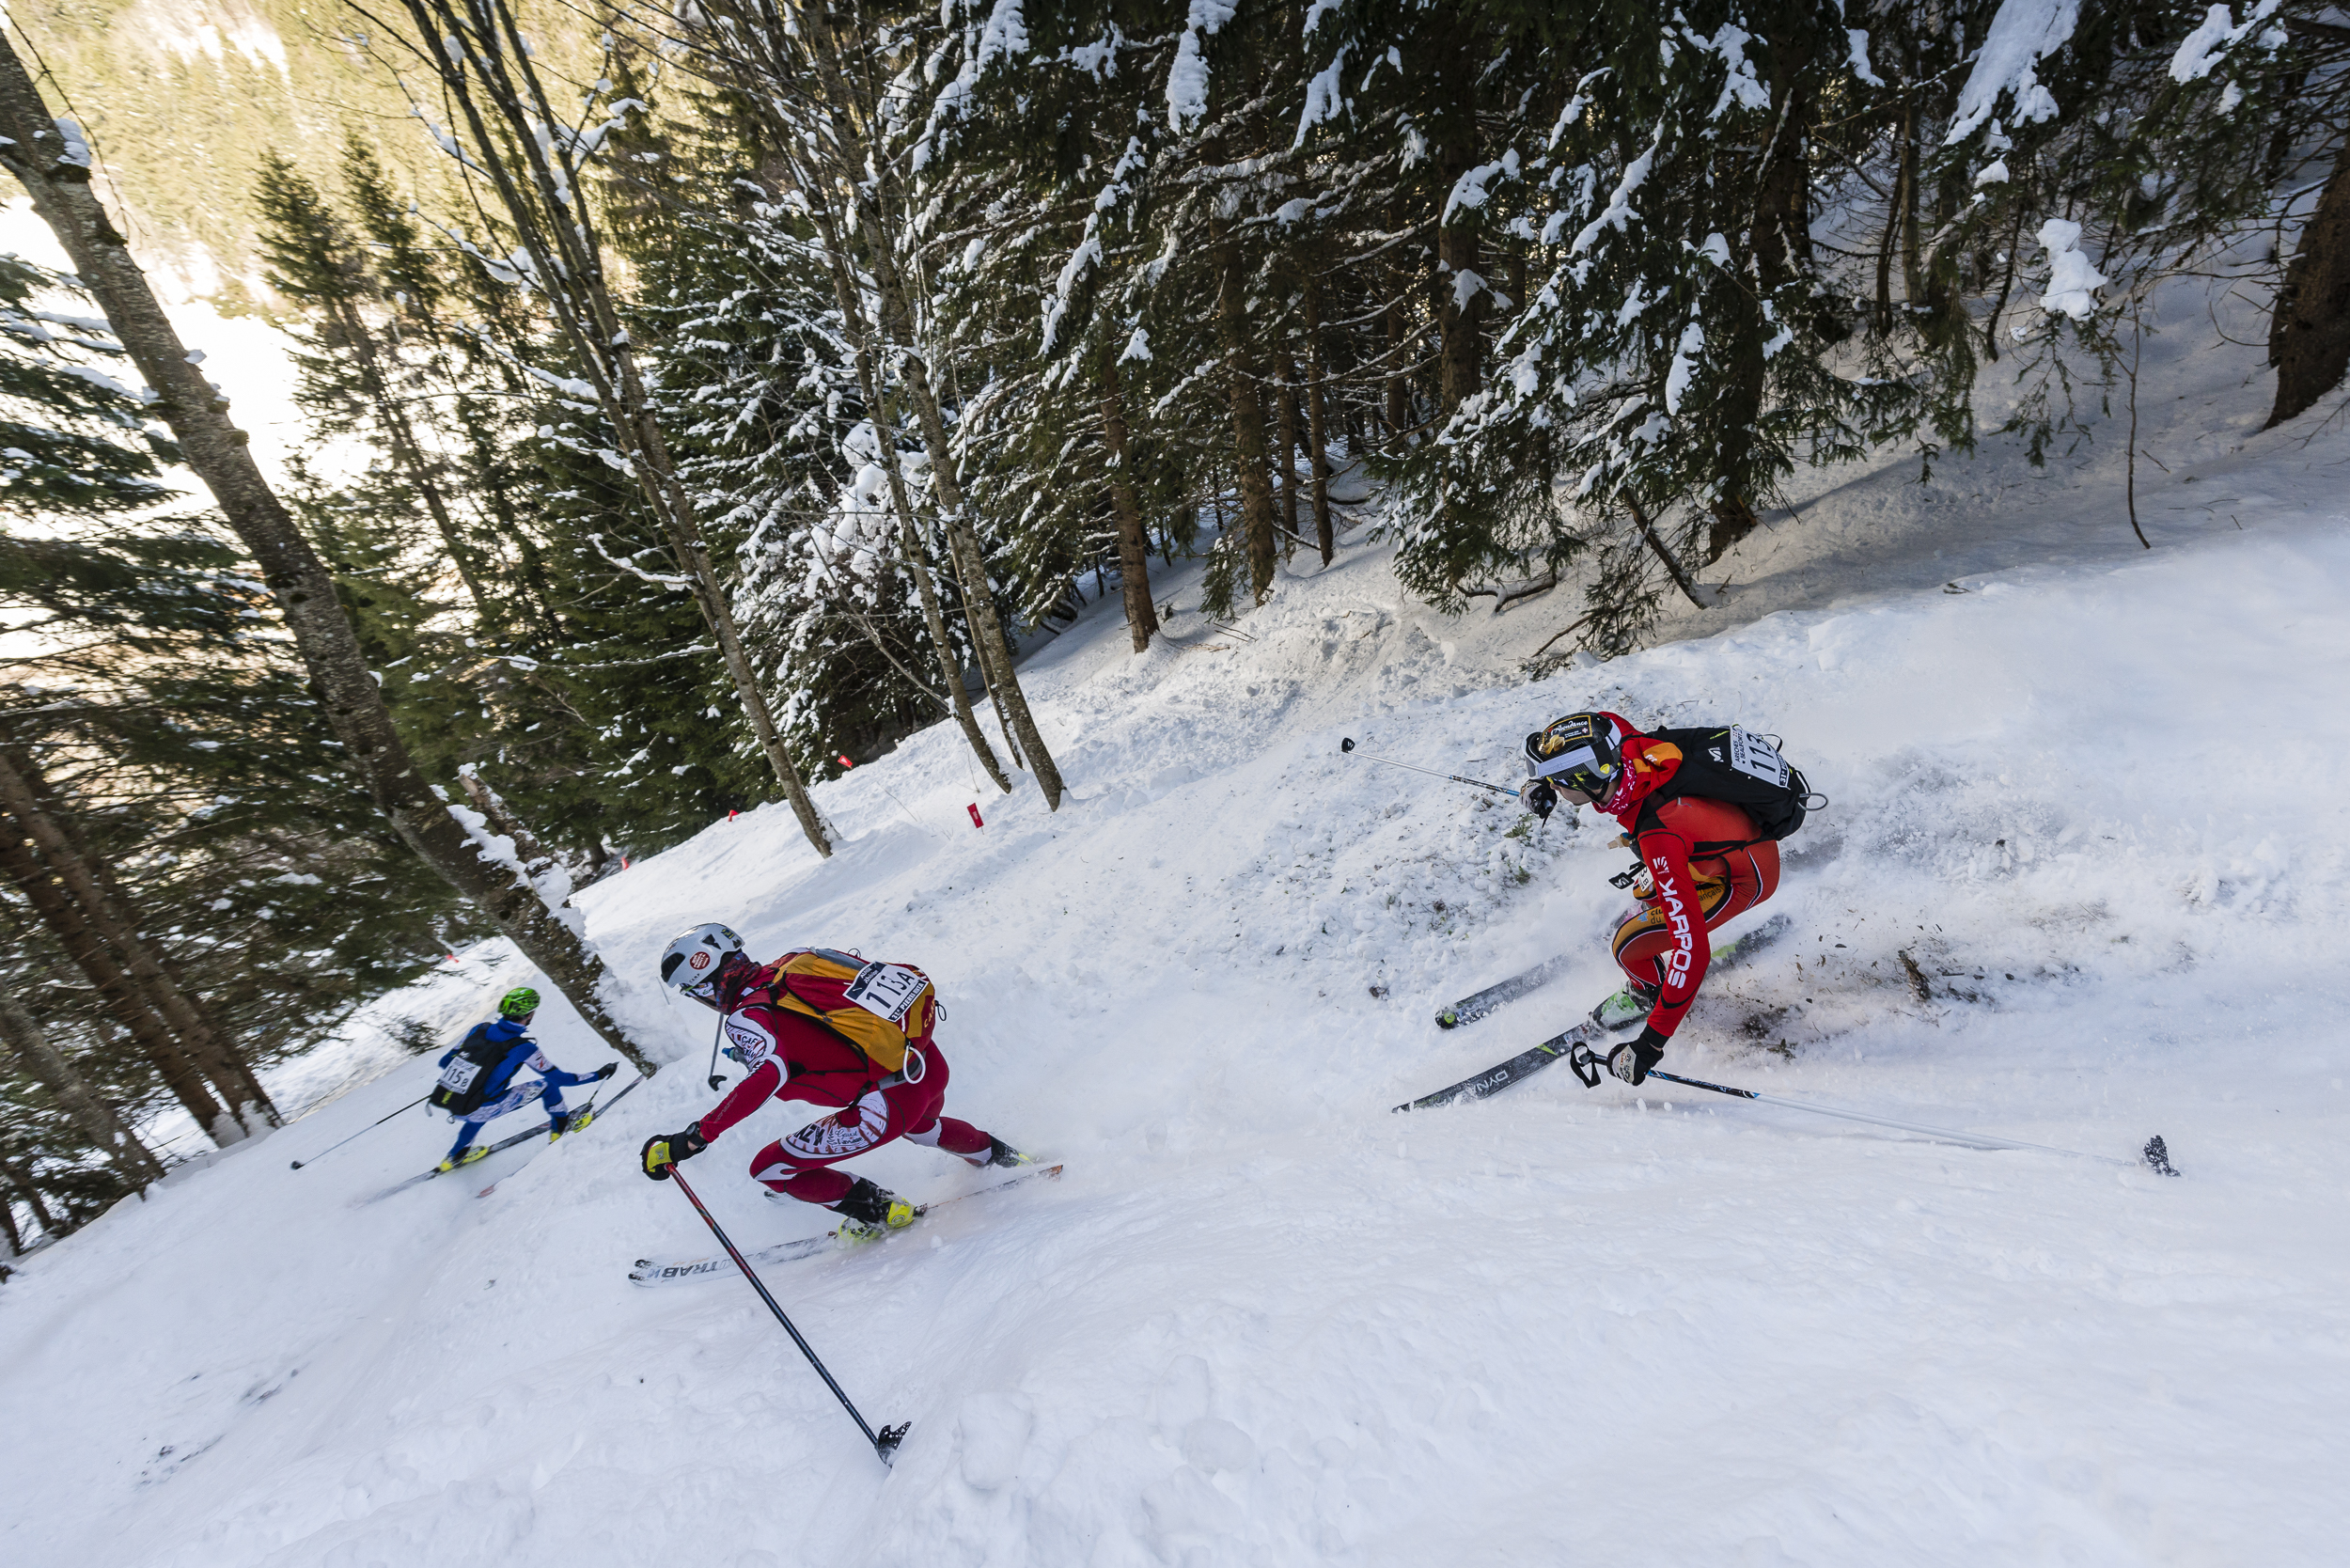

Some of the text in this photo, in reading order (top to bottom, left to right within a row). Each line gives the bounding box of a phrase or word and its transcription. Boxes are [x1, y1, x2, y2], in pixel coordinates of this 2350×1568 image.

[1747, 733, 1777, 774] 113
[1699, 886, 1722, 902] ançais
[1651, 916, 1662, 924] du
[1658, 876, 1693, 989] KARPOS
